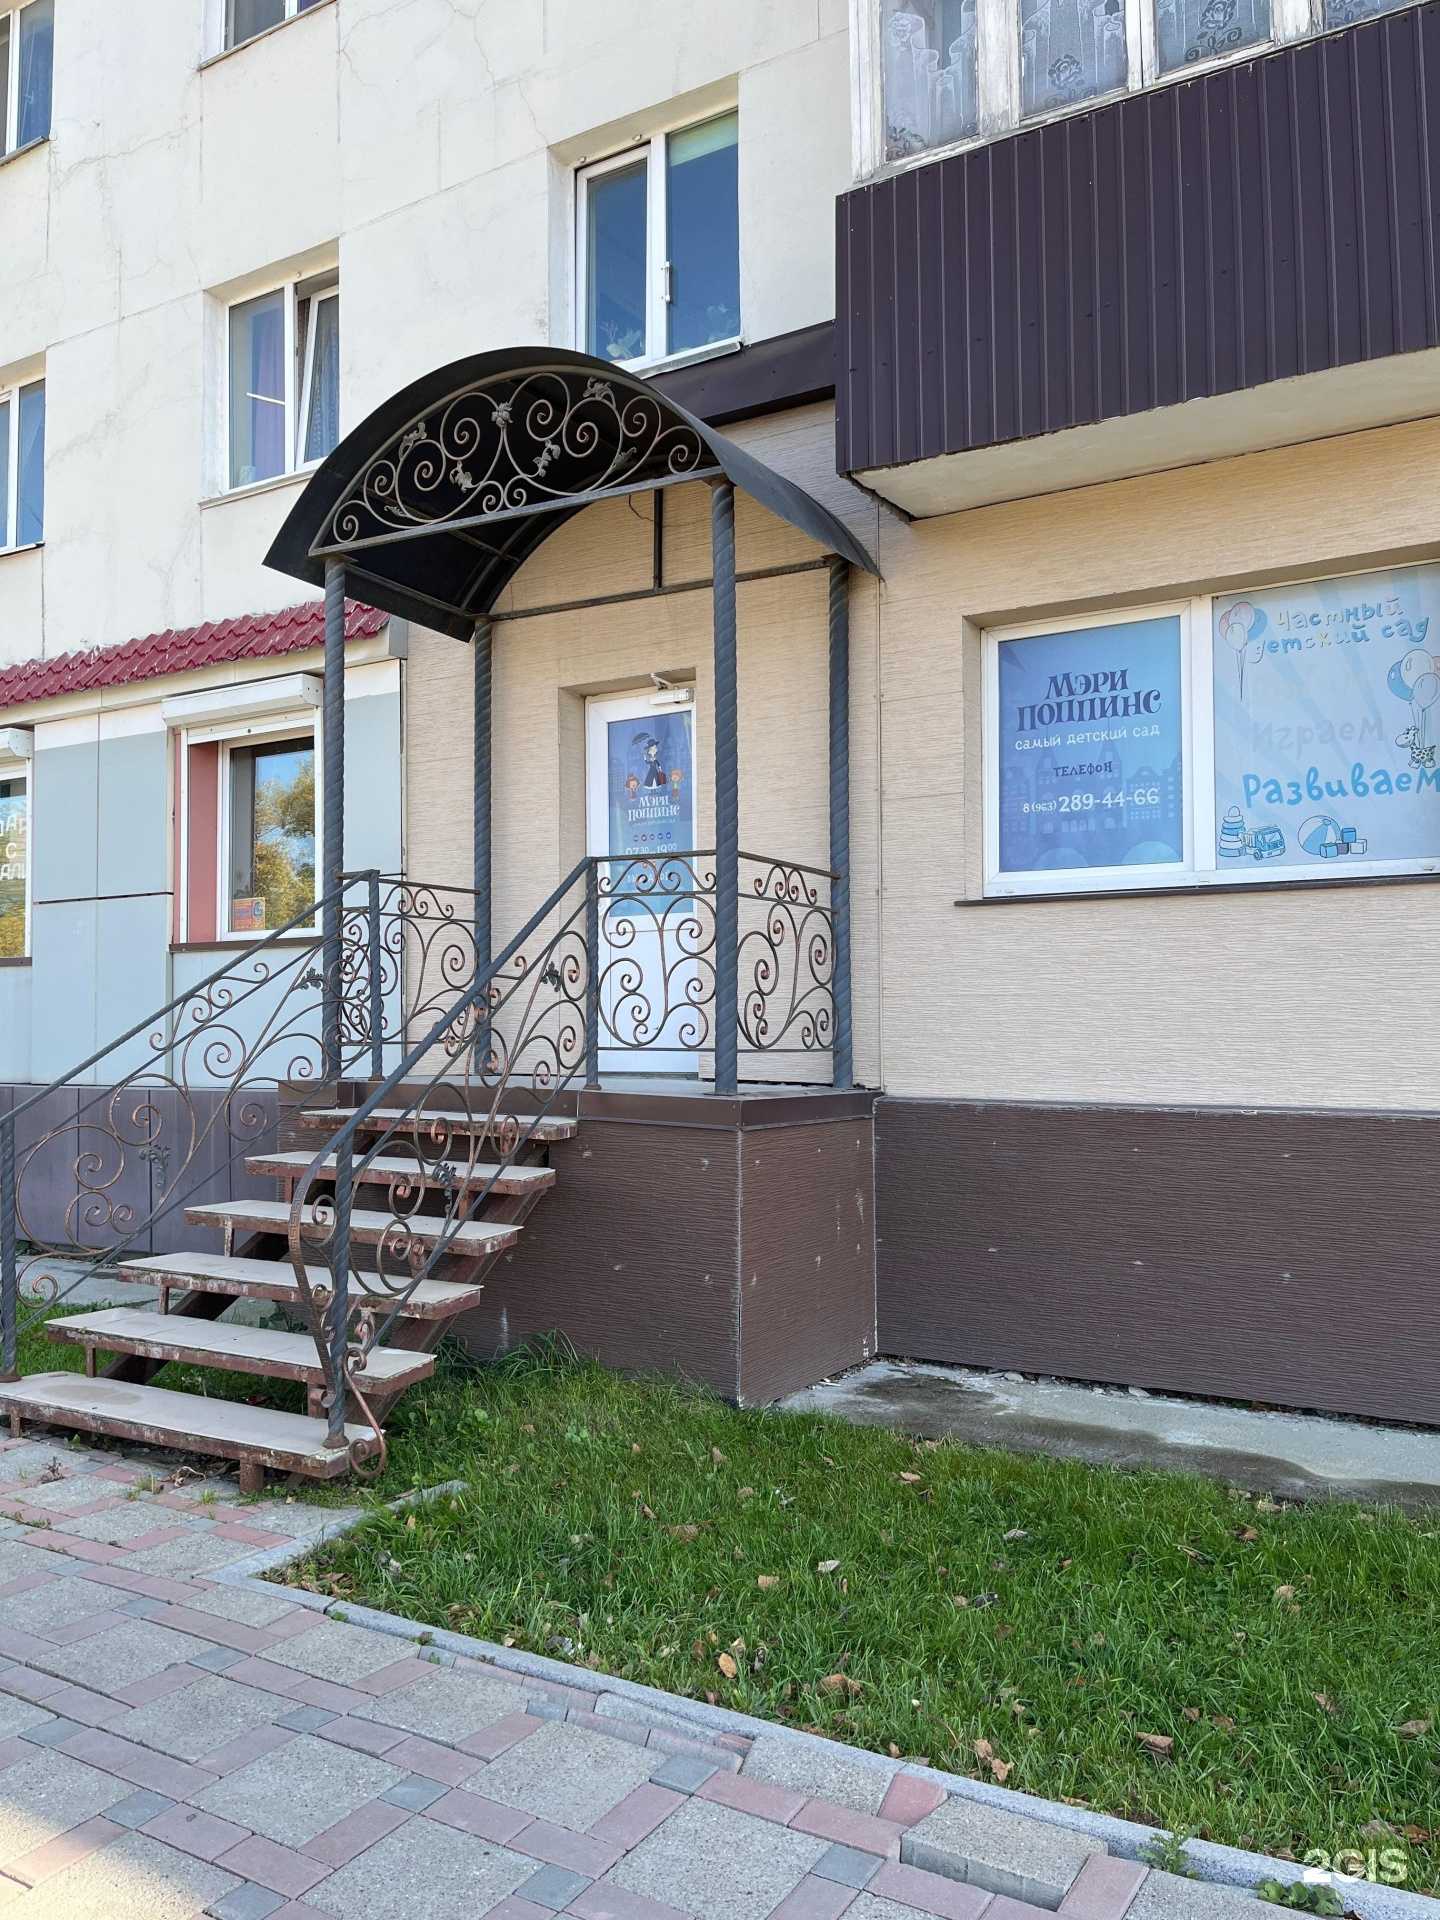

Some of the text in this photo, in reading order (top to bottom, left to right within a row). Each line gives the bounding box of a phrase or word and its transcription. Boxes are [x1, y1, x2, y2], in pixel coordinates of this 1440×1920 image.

[1248, 616, 1430, 664] детский сад
[1016, 689, 1162, 732] ПОППИНС
[1015, 724, 1161, 750] самый детский сад
[1252, 716, 1384, 760] Играем
